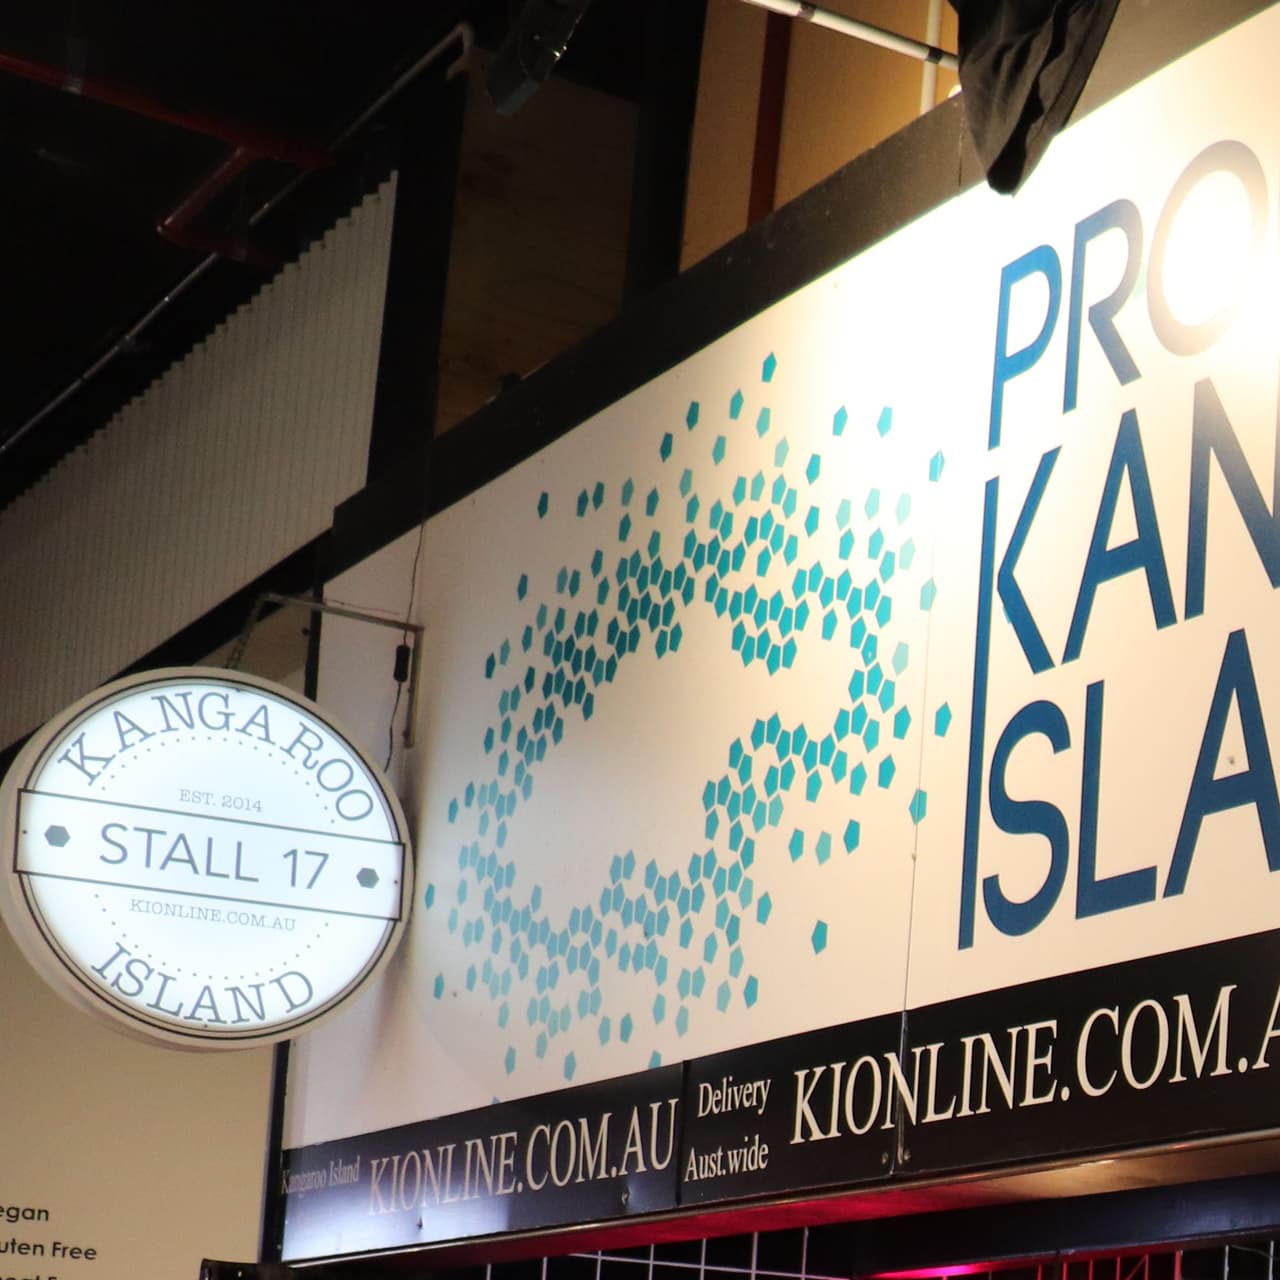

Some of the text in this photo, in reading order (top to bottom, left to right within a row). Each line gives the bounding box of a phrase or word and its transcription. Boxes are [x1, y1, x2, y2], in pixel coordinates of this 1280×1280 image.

[58, 690, 374, 828] KANGAROO
[179, 787, 264, 813] EST. 2014
[98, 822, 329, 890] STALL 17
[130, 897, 297, 932] KIONLINE.COM.AU
[90, 940, 315, 1025] ISLAND
[696, 1074, 772, 1121] Delivery
[369, 1096, 679, 1219] KIONLINE.COM.AU
[684, 1138, 770, 1184] Aust.wide
[52, 1241, 98, 1261] Free
